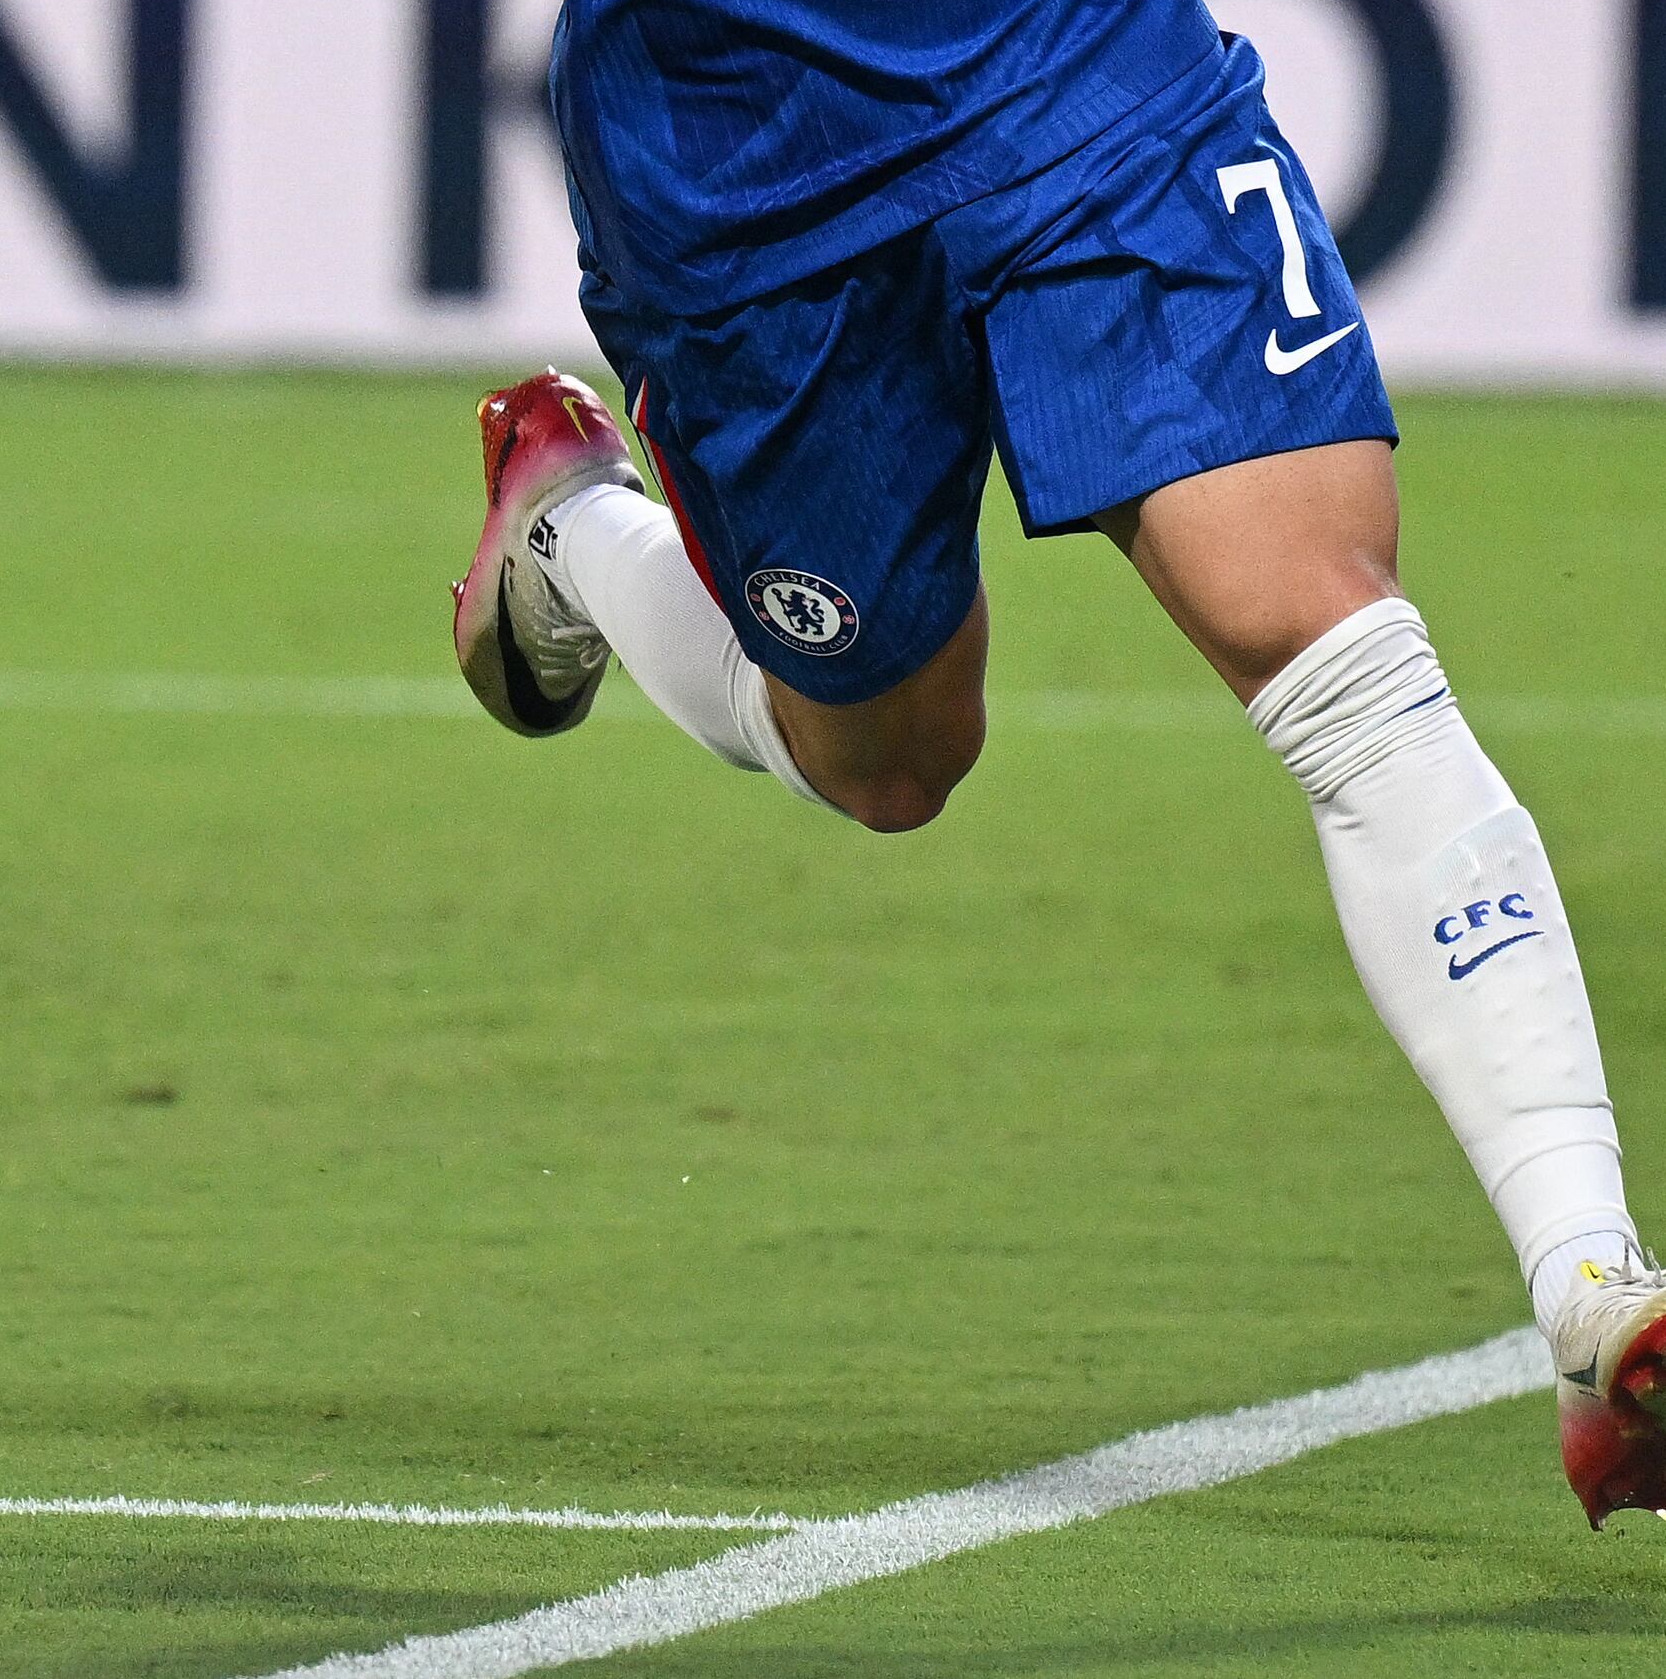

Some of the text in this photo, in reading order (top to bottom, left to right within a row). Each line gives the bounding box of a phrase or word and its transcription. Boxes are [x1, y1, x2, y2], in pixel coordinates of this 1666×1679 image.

[1216, 158, 1321, 318] 7
[754, 572, 820, 591] CHELSEA
[779, 632, 849, 652] FOOTBALL CLUB
[1433, 892, 1534, 945] CFC
